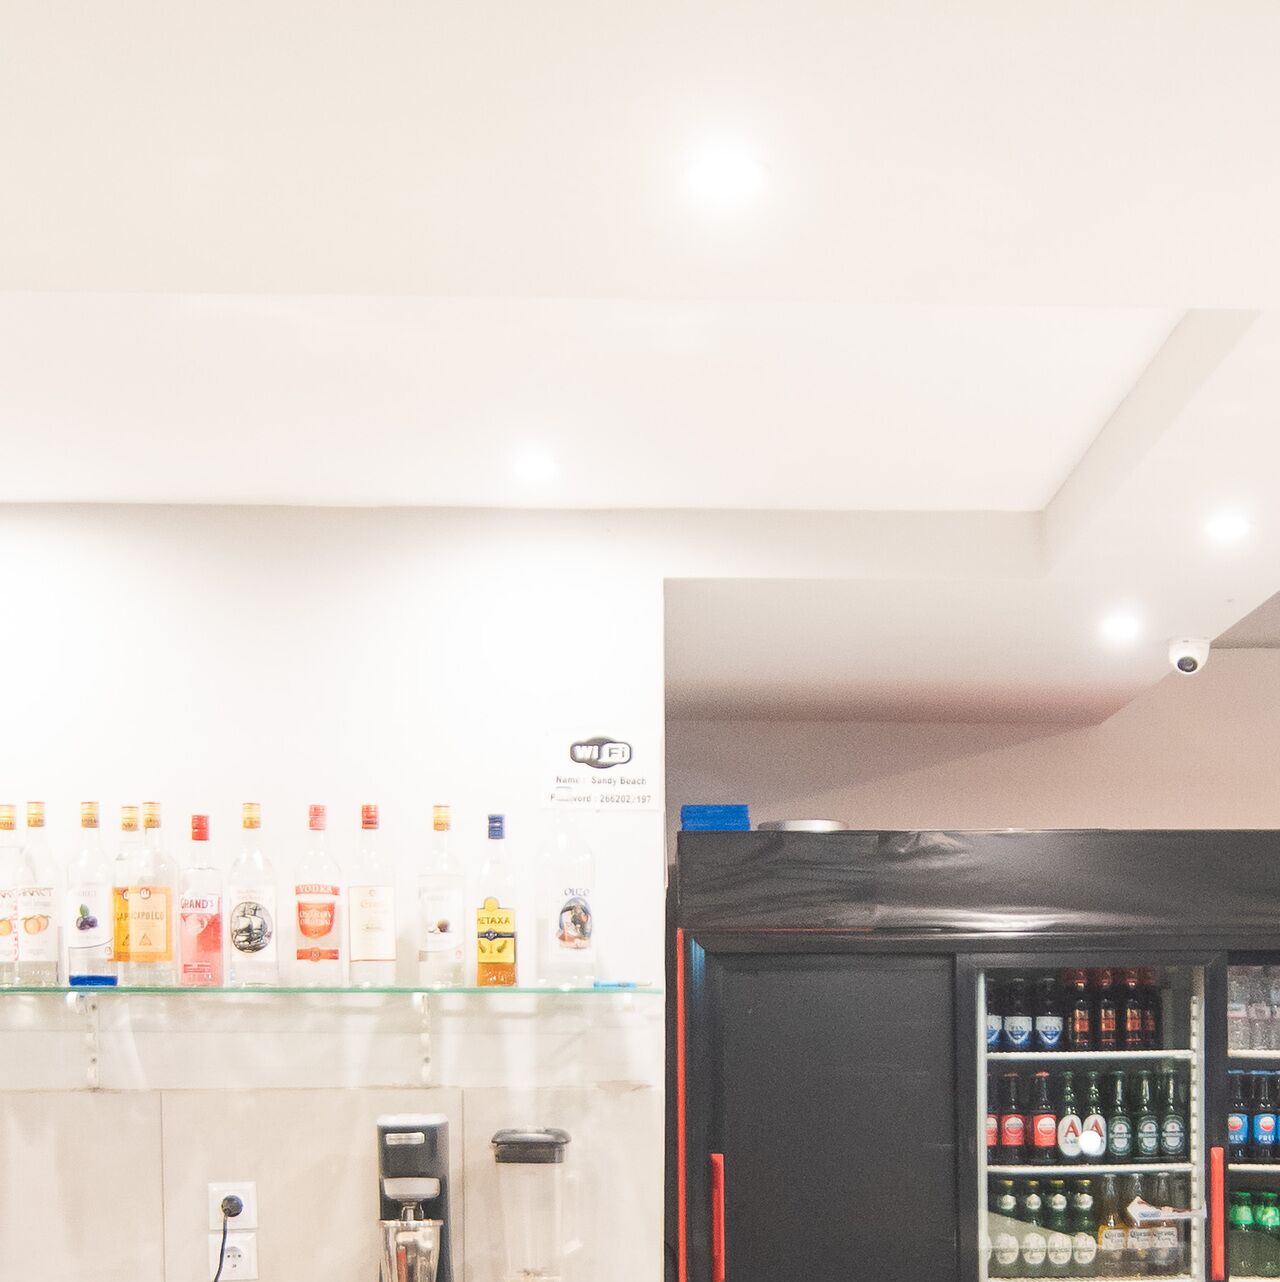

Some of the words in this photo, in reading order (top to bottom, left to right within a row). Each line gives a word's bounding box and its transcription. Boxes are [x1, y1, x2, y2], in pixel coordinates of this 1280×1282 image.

[591, 776, 617, 787] Sandy
[620, 776, 647, 785] Beach
[1064, 1119, 1080, 1138] A
